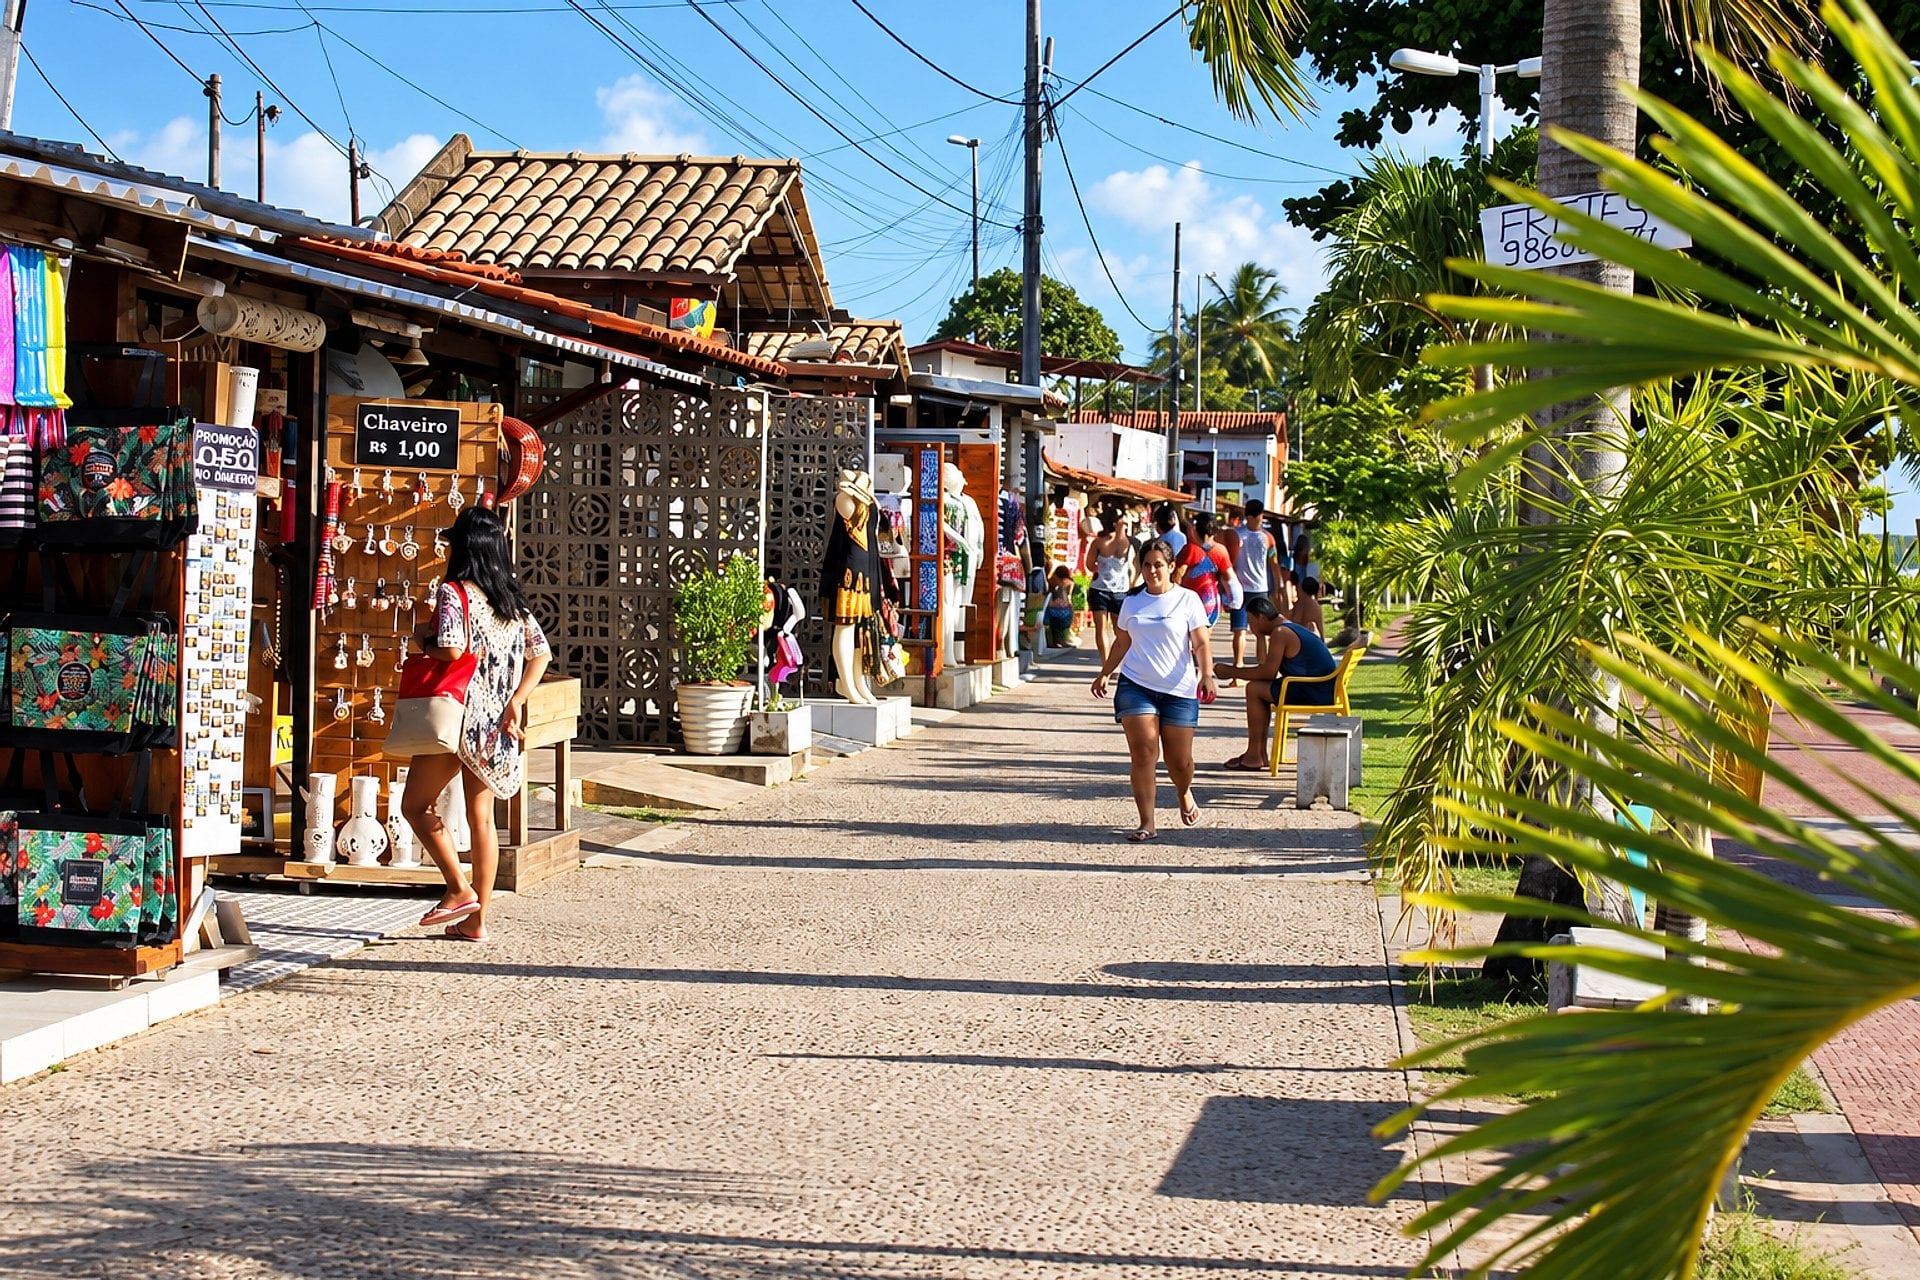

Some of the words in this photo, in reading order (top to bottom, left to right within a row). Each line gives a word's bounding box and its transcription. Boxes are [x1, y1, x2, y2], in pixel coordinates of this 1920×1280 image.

[363, 413, 448, 434] Chaveiro
[195, 429, 257, 449] PROMOÇÃO
[368, 440, 388, 454] R$
[398, 440, 441, 460] 1,00
[196, 467, 211, 481] NO
